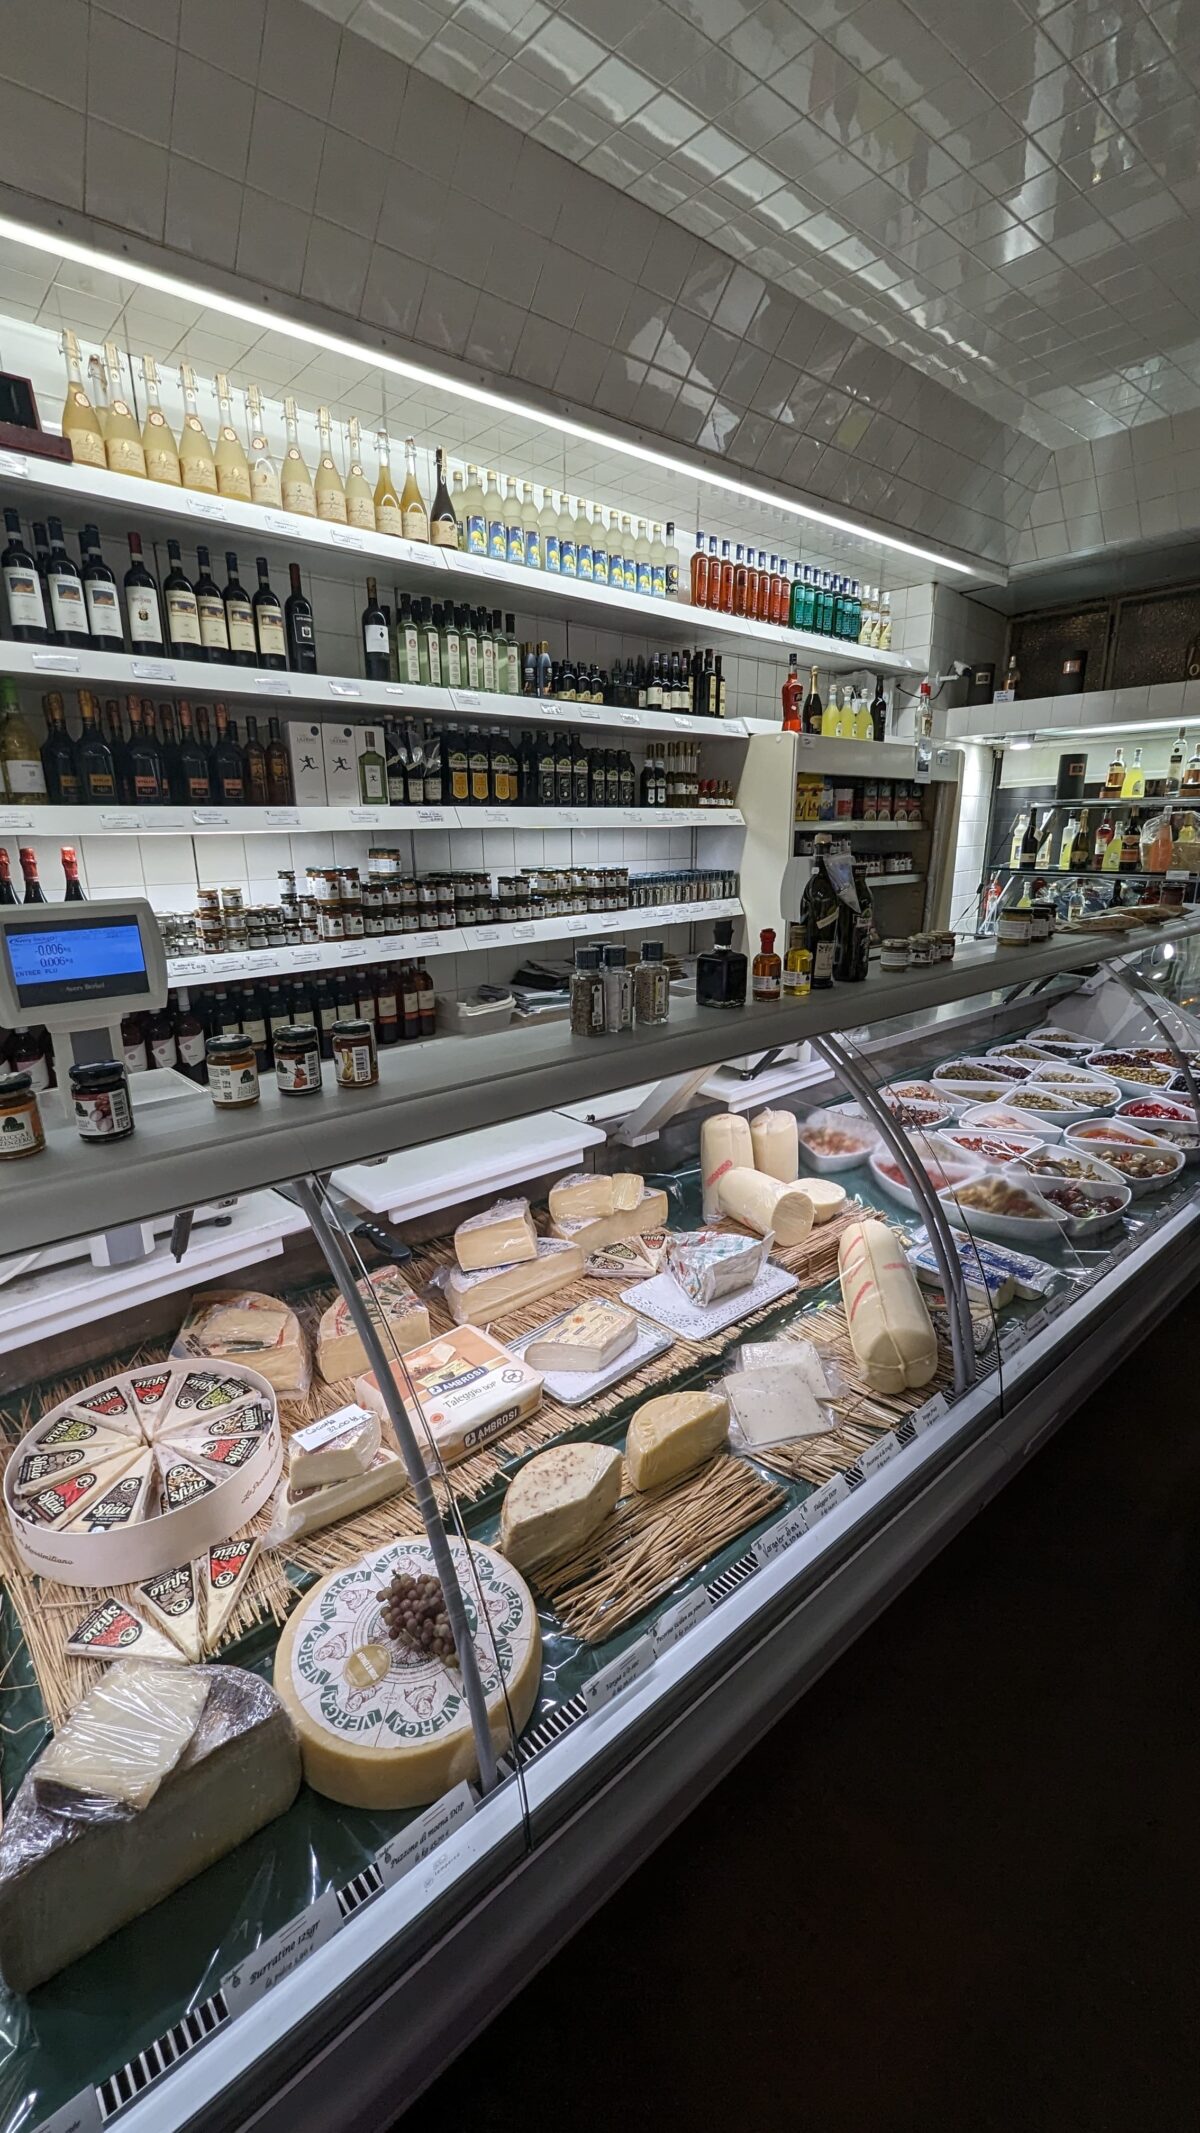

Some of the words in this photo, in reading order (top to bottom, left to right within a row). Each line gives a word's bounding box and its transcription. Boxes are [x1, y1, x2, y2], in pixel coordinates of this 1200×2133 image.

[134, 1376, 169, 1388] Sfizio
[443, 1367, 485, 1391] AMBROSI
[442, 1386, 482, 1409] Taleggio
[45, 1419, 74, 1443] Sfizio
[478, 1407, 518, 1441] AMBROSI
[224, 1438, 249, 1465] Sfizio
[29, 1455, 49, 1479] Sfizio
[39, 1490, 65, 1515] Sfizio
[170, 1480, 207, 1502] Sfizio
[92, 1503, 132, 1517] Sfizio
[211, 1541, 251, 1559] Sfizio
[150, 1570, 190, 1597] Sfizio
[322, 1570, 365, 1617] VERGA
[498, 1581, 523, 1637] VERGA
[83, 1604, 122, 1643] Sfizio
[298, 1627, 321, 1685] VERGA
[321, 1688, 374, 1732] VERGA
[391, 1700, 458, 1738] VERGA
